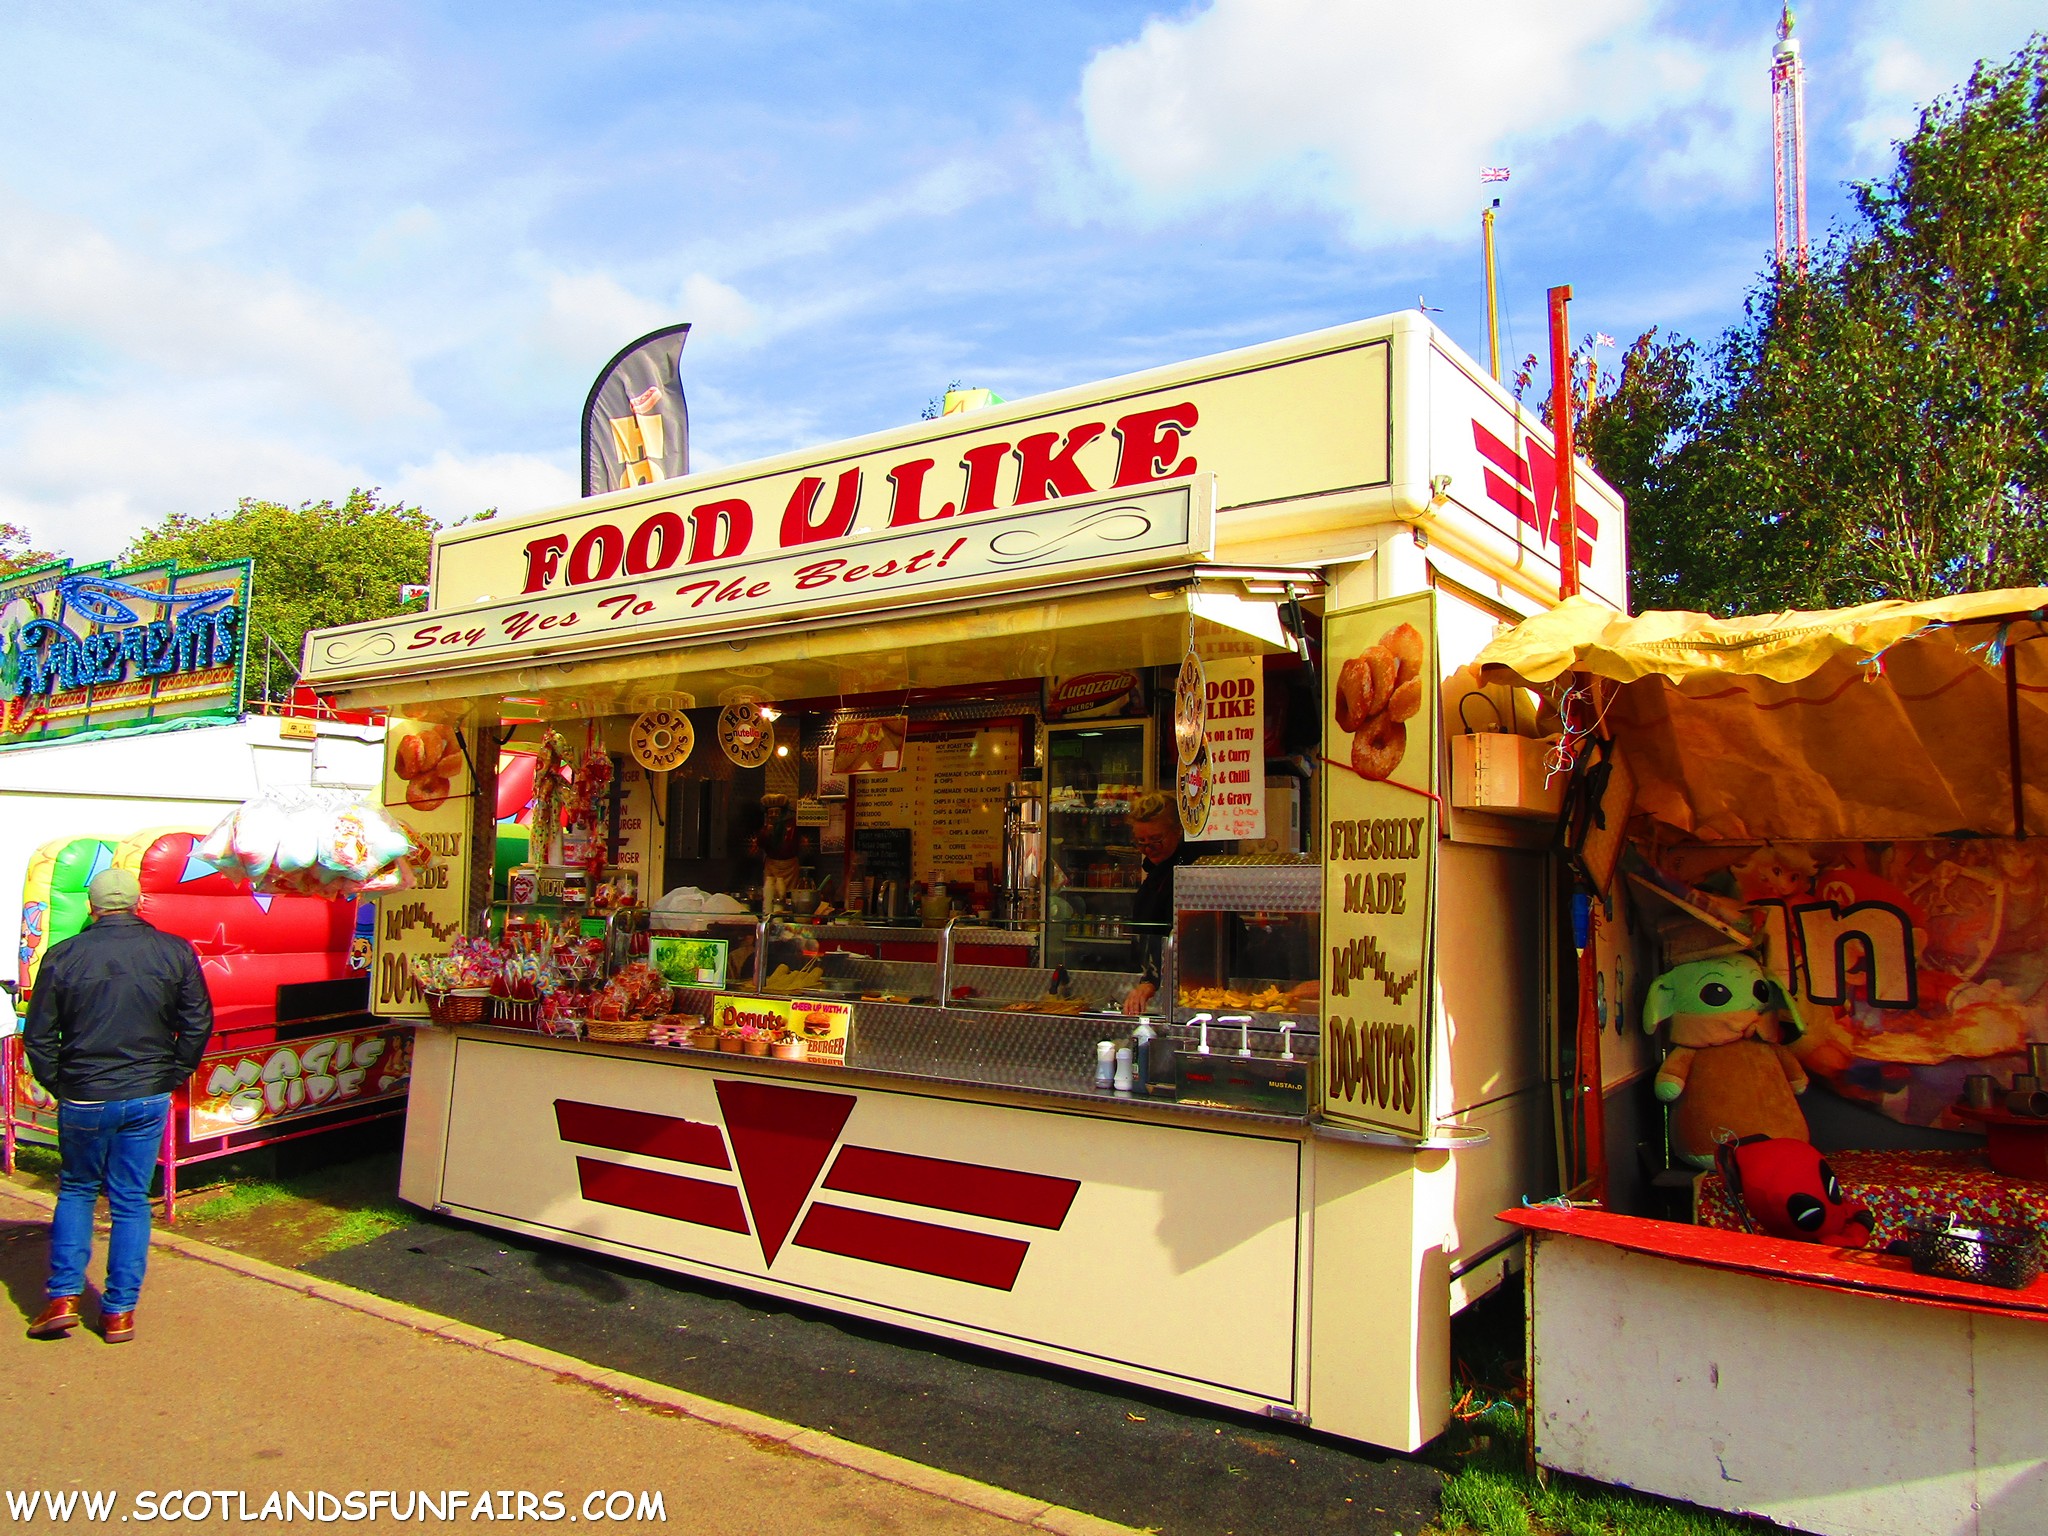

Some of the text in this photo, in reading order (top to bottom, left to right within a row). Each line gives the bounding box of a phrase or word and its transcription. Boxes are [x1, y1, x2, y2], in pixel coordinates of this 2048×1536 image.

[521, 401, 1199, 596] FOOD U LIKE
[407, 536, 968, 653] Say Yes To The Best!
[1058, 674, 1133, 701] Lucozade
[1206, 678, 1255, 699] OOD
[724, 706, 764, 729] HOT
[1066, 701, 1095, 713] ENERGY
[1206, 698, 1255, 720] LIKE
[639, 711, 686, 736] HOT
[732, 727, 761, 739] nutella
[1214, 731, 1226, 742] on
[1226, 730, 1233, 740] a
[1235, 727, 1254, 741] Tray
[637, 735, 688, 766] DONUTS
[724, 731, 769, 761] DONUTS
[1218, 751, 1226, 762] &
[1227, 749, 1251, 762] Curry
[1218, 773, 1226, 784] &
[1228, 769, 1250, 784] Chilli
[1217, 794, 1225, 805] &
[1226, 792, 1252, 806] Gravy
[1329, 816, 1425, 860] FRESHLY
[1343, 872, 1407, 915] MADE
[723, 1005, 782, 1031] Donuts
[791, 1001, 848, 1014] CHEER UP WITH A
[807, 1037, 845, 1055] EBURGER
[206, 1038, 386, 1097] MAGIC
[228, 1067, 367, 1126] SLIDE
